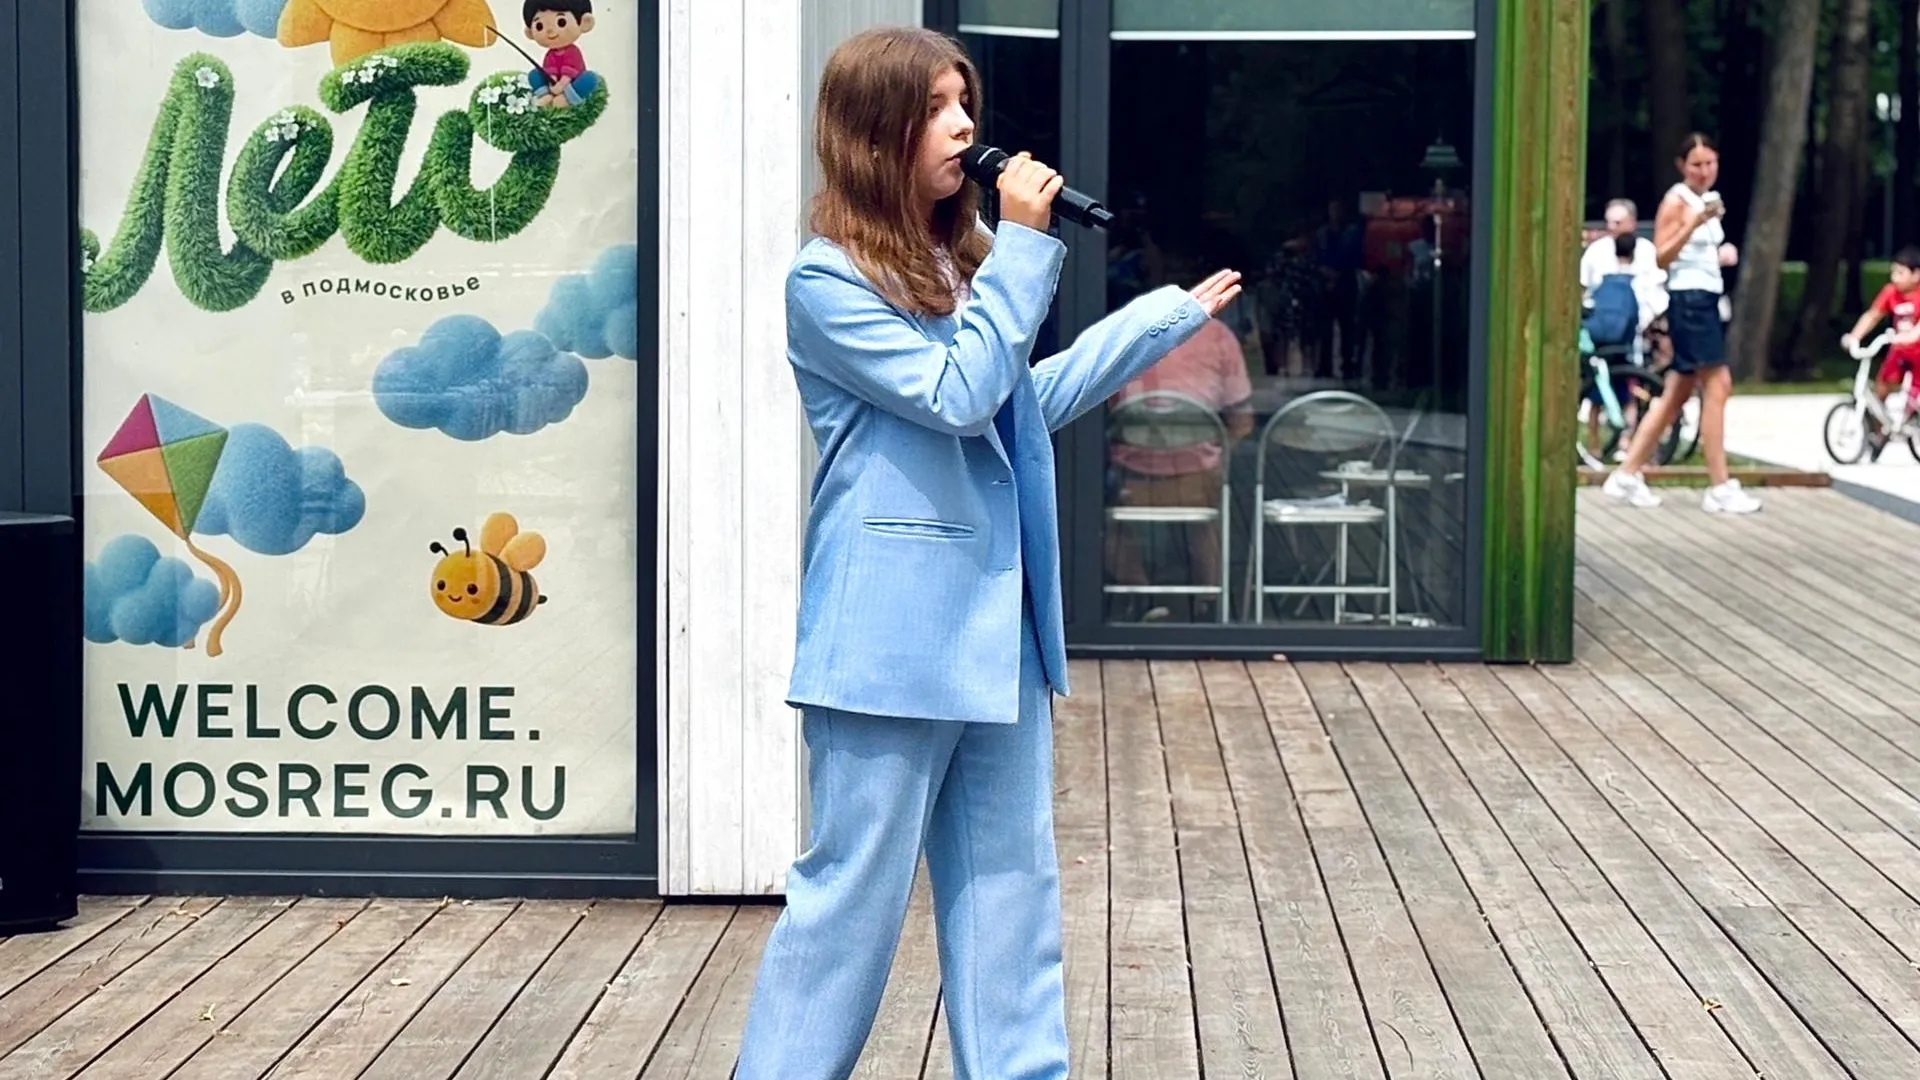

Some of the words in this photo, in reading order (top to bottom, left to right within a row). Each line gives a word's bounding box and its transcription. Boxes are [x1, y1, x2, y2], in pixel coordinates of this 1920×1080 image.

[83, 43, 609, 313] Лето
[280, 290, 295, 305] в
[302, 276, 481, 302] подмосковье
[117, 683, 541, 741] WELCOME.
[95, 761, 567, 820] MOSREG.RU
